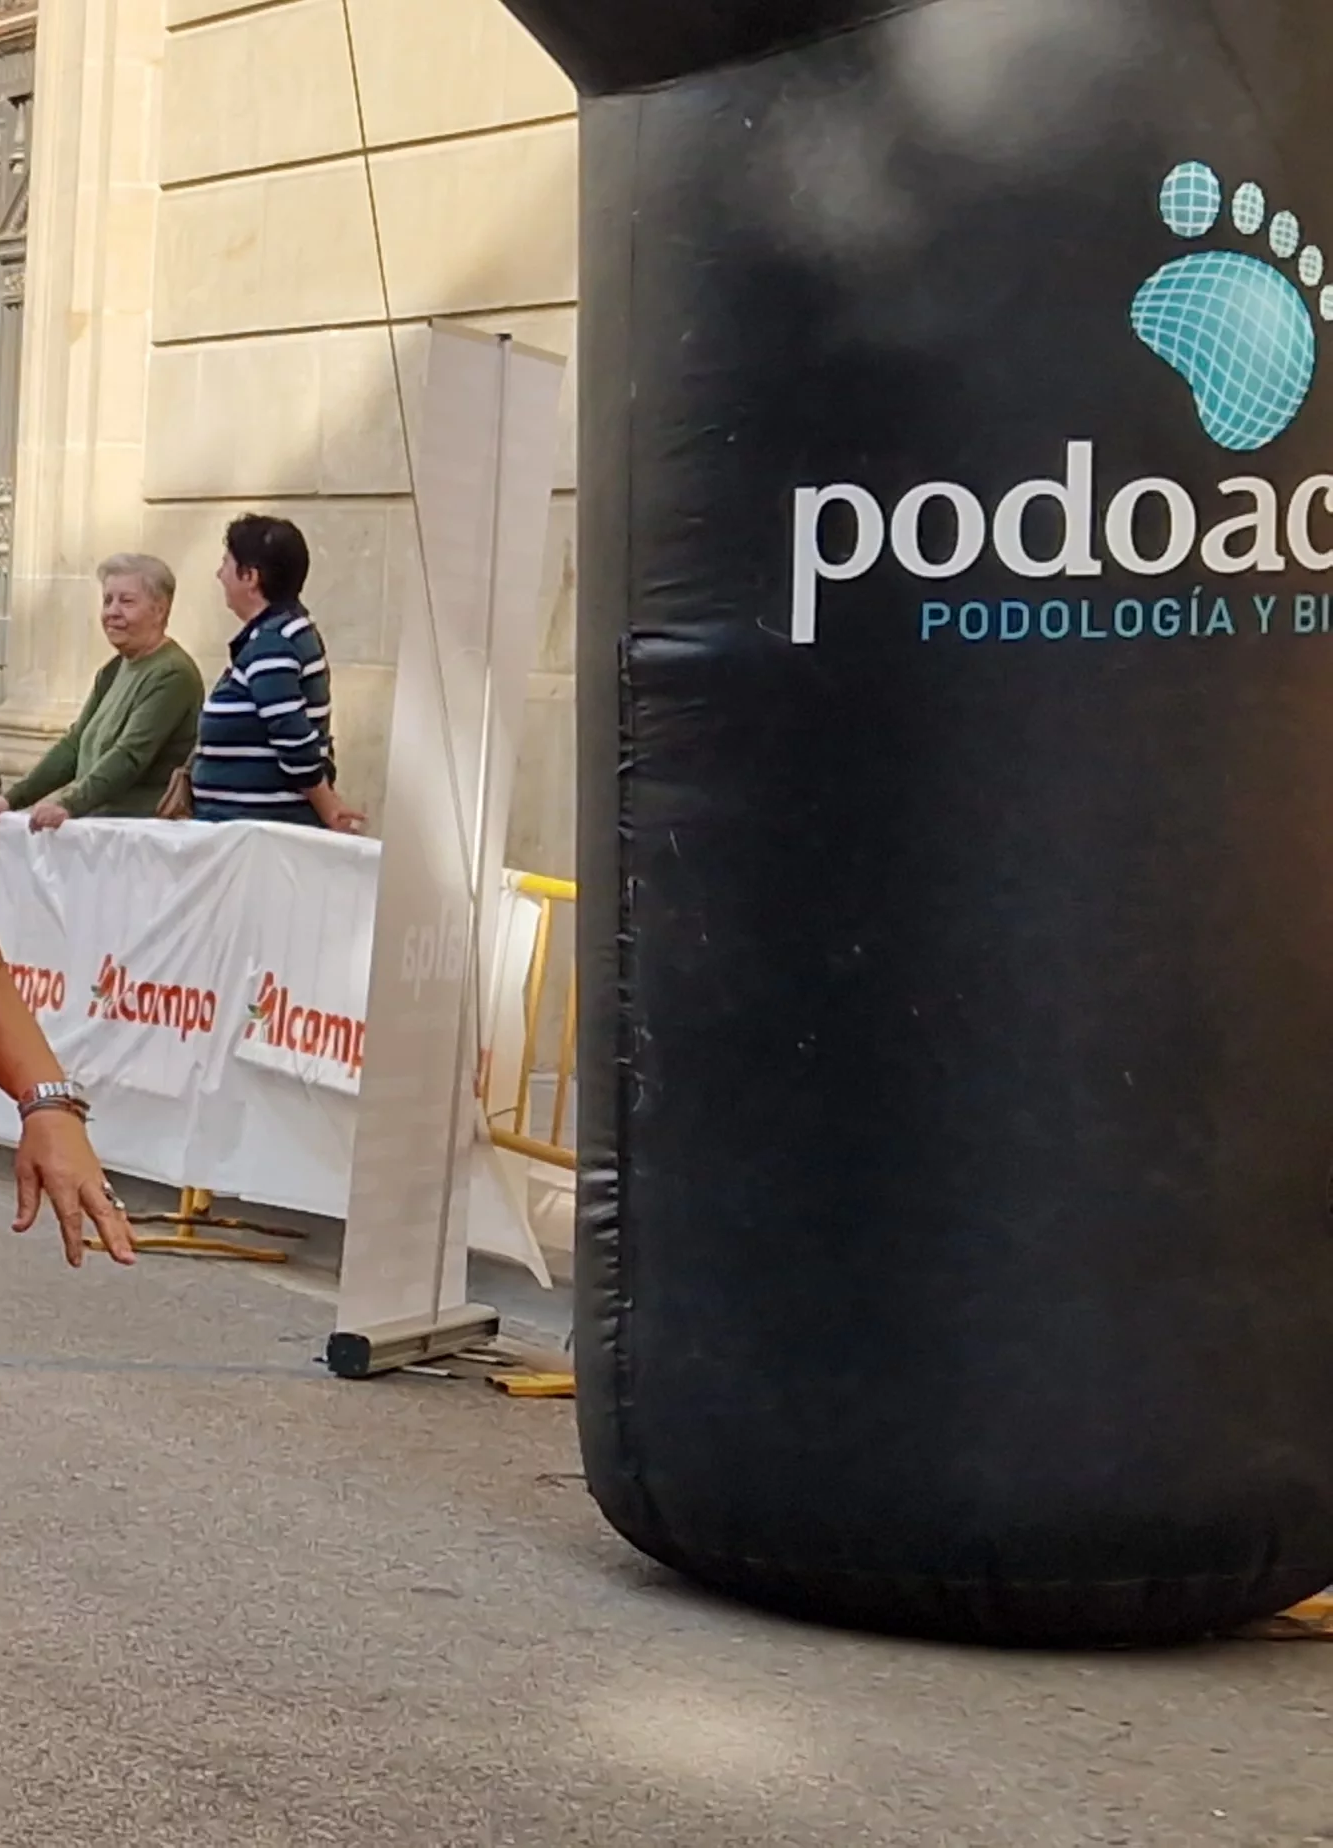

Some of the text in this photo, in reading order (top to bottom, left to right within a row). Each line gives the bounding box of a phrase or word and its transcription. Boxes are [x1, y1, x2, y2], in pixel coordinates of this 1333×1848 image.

[791, 440, 1333, 644] podoac
[920, 586, 1235, 641] PODOLOGÍA
[1252, 593, 1277, 635] Y
[87, 953, 217, 1043] Alcampo
